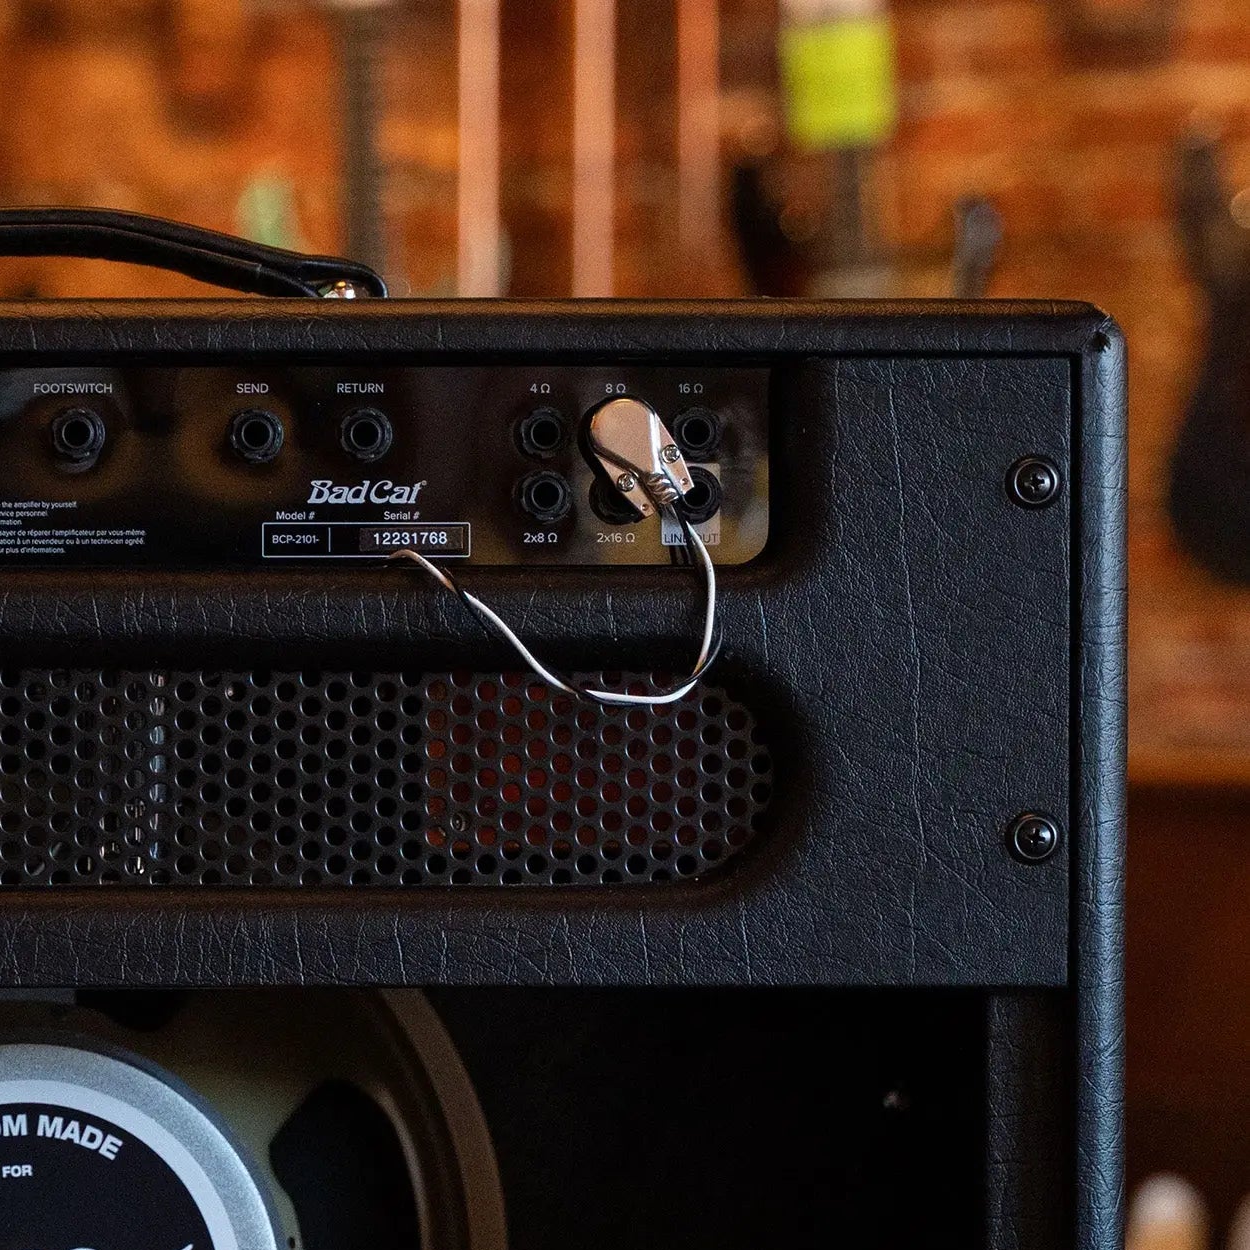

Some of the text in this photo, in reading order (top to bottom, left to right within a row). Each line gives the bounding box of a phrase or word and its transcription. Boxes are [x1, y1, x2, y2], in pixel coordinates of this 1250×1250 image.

[34, 383, 113, 393] FOOTSWITCH
[236, 383, 269, 393] SEND
[336, 383, 384, 393] RETURN
[530, 383, 537, 394] 4
[605, 383, 613, 394] 8
[678, 383, 690, 394] 16
[276, 511, 306, 520] Model
[383, 511, 411, 520] Serial
[373, 532, 447, 545] 12231768
[523, 533, 545, 544] 2x8
[597, 533, 622, 544] 2x16
[664, 533, 687, 544] LIN
[37, 1115, 123, 1160] MADE
[1, 1164, 33, 1179] FOR
